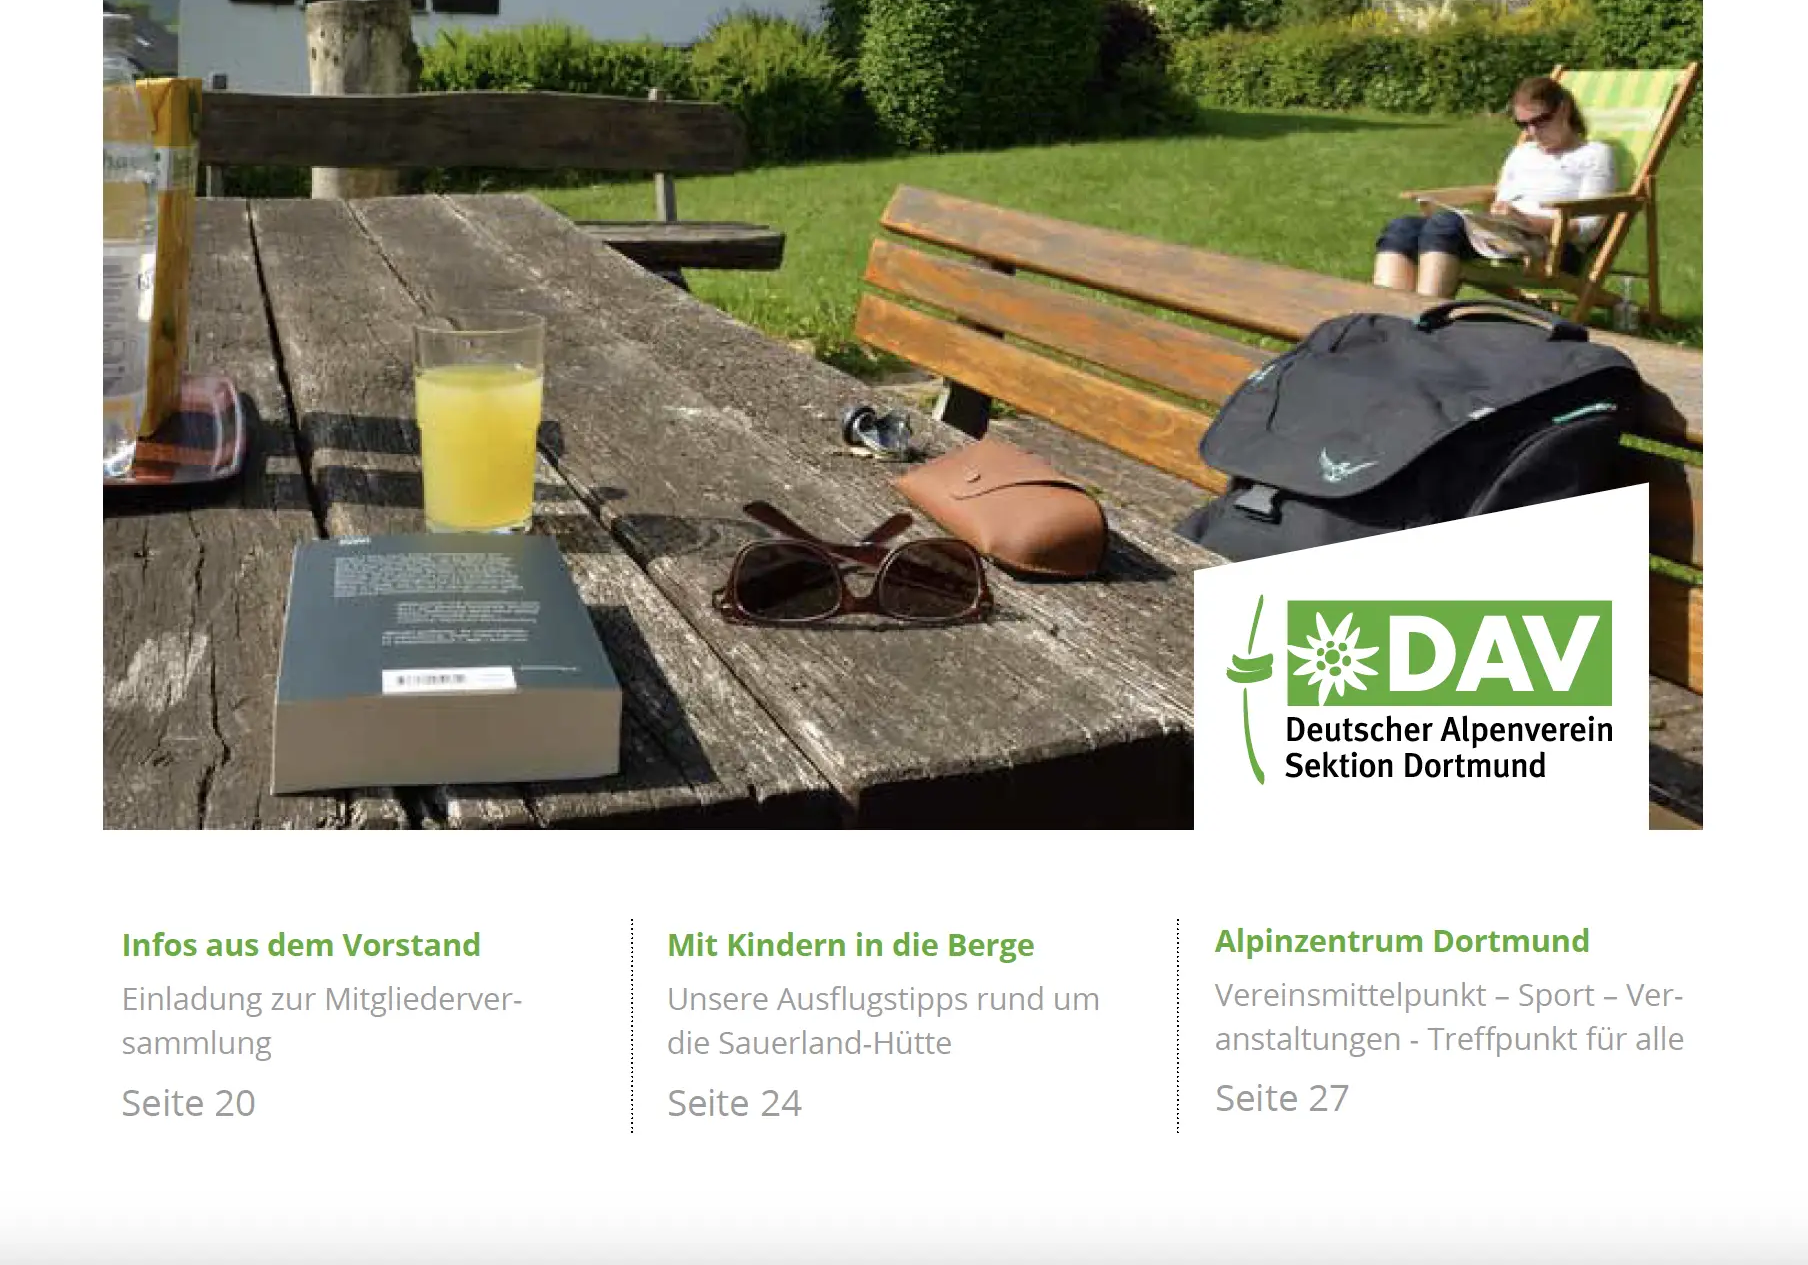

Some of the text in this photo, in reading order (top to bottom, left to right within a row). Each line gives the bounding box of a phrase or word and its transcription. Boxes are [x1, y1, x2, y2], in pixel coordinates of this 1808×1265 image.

[123, 932, 481, 956] Infos aus dem Vorstand
[668, 932, 1035, 963] Mit Kindern in die Berge
[1215, 927, 1590, 959] Alpinzentrum Dortmund
[123, 986, 522, 1017] Einladung zur Mitgliederver-
[668, 986, 1099, 1017] Unsere Ausflugstipps rund um
[1215, 982, 1486, 1013] Vereinsmittelpunkt
[1519, 983, 1595, 1013] Sport
[1626, 983, 1683, 1007] Ver-
[122, 1030, 272, 1061] sammlung
[667, 1030, 952, 1055] die Sauerland-Hütte
[1215, 1026, 1400, 1057] anstaltungen
[1427, 1026, 1578, 1057] Treffpunkt
[1586, 1026, 1627, 1050] für
[1636, 1026, 1684, 1050] alle
[122, 1089, 255, 1117] Seite 20
[668, 1089, 803, 1117] Seite 24
[1216, 1084, 1349, 1112] Seite 27
